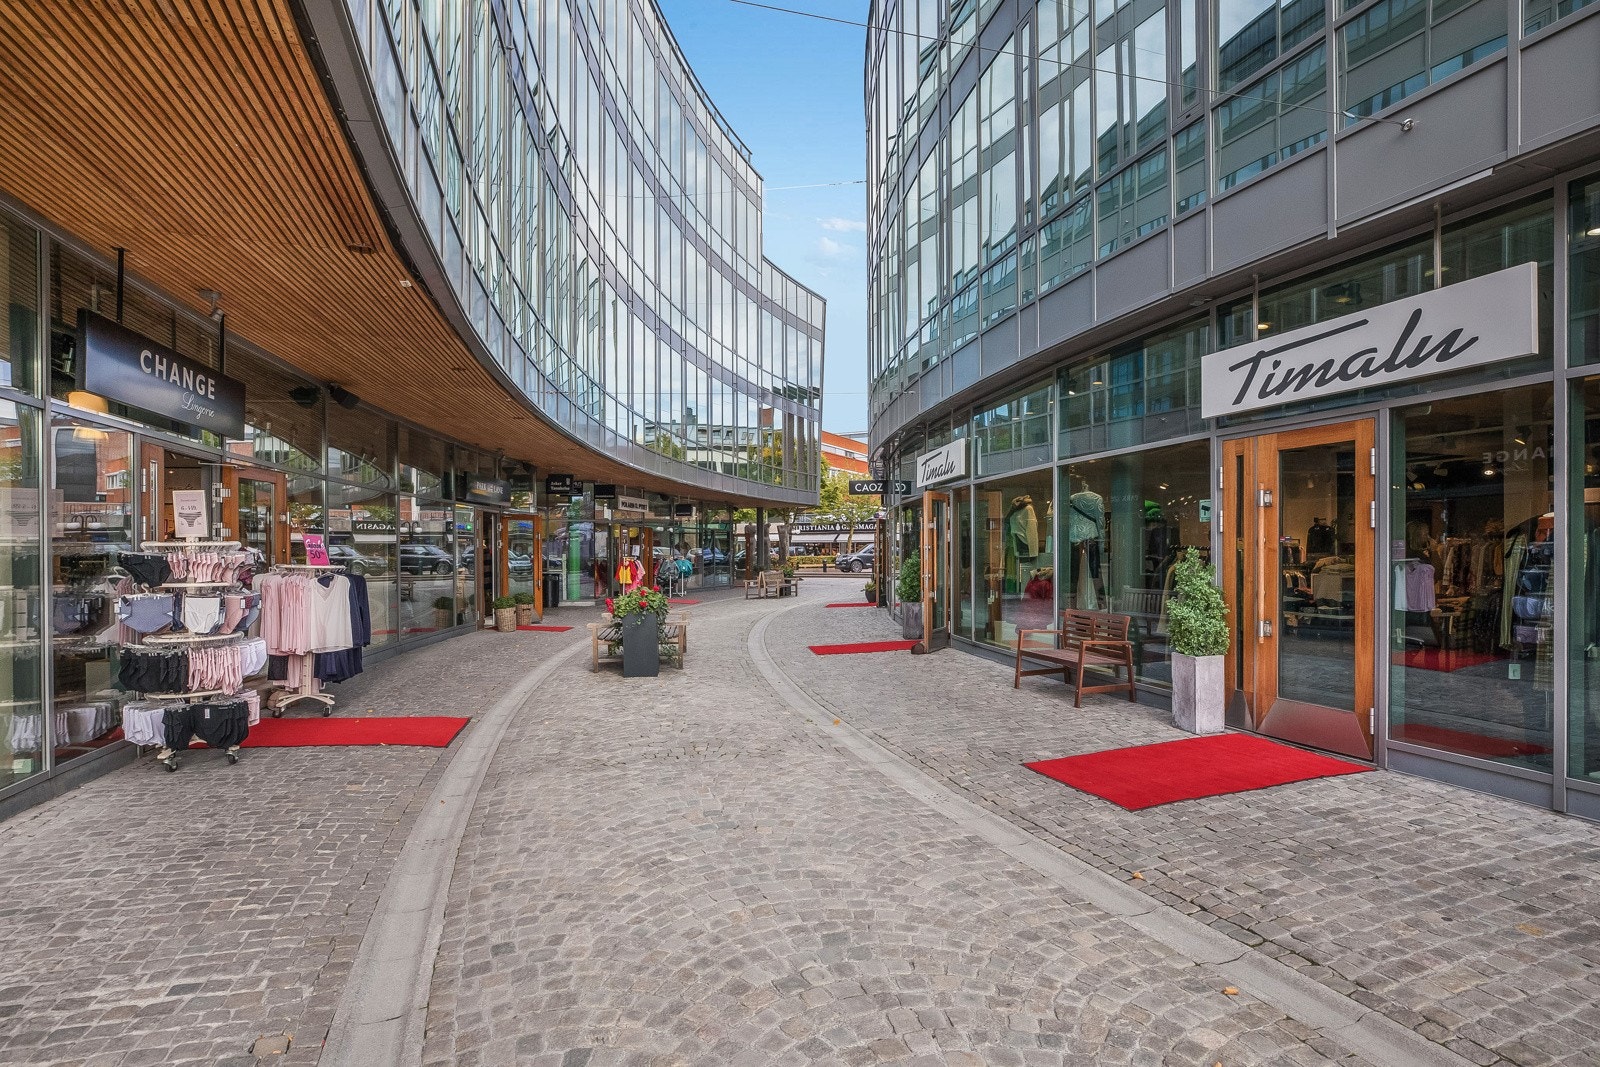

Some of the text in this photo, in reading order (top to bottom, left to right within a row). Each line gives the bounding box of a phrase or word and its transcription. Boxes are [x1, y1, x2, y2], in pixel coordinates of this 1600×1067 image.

[1228, 308, 1479, 405] Timalu
[140, 349, 215, 400] CHANGE
[181, 391, 215, 419] Lingerie
[921, 450, 955, 483] Timalu
[854, 483, 883, 492] CAOZ
